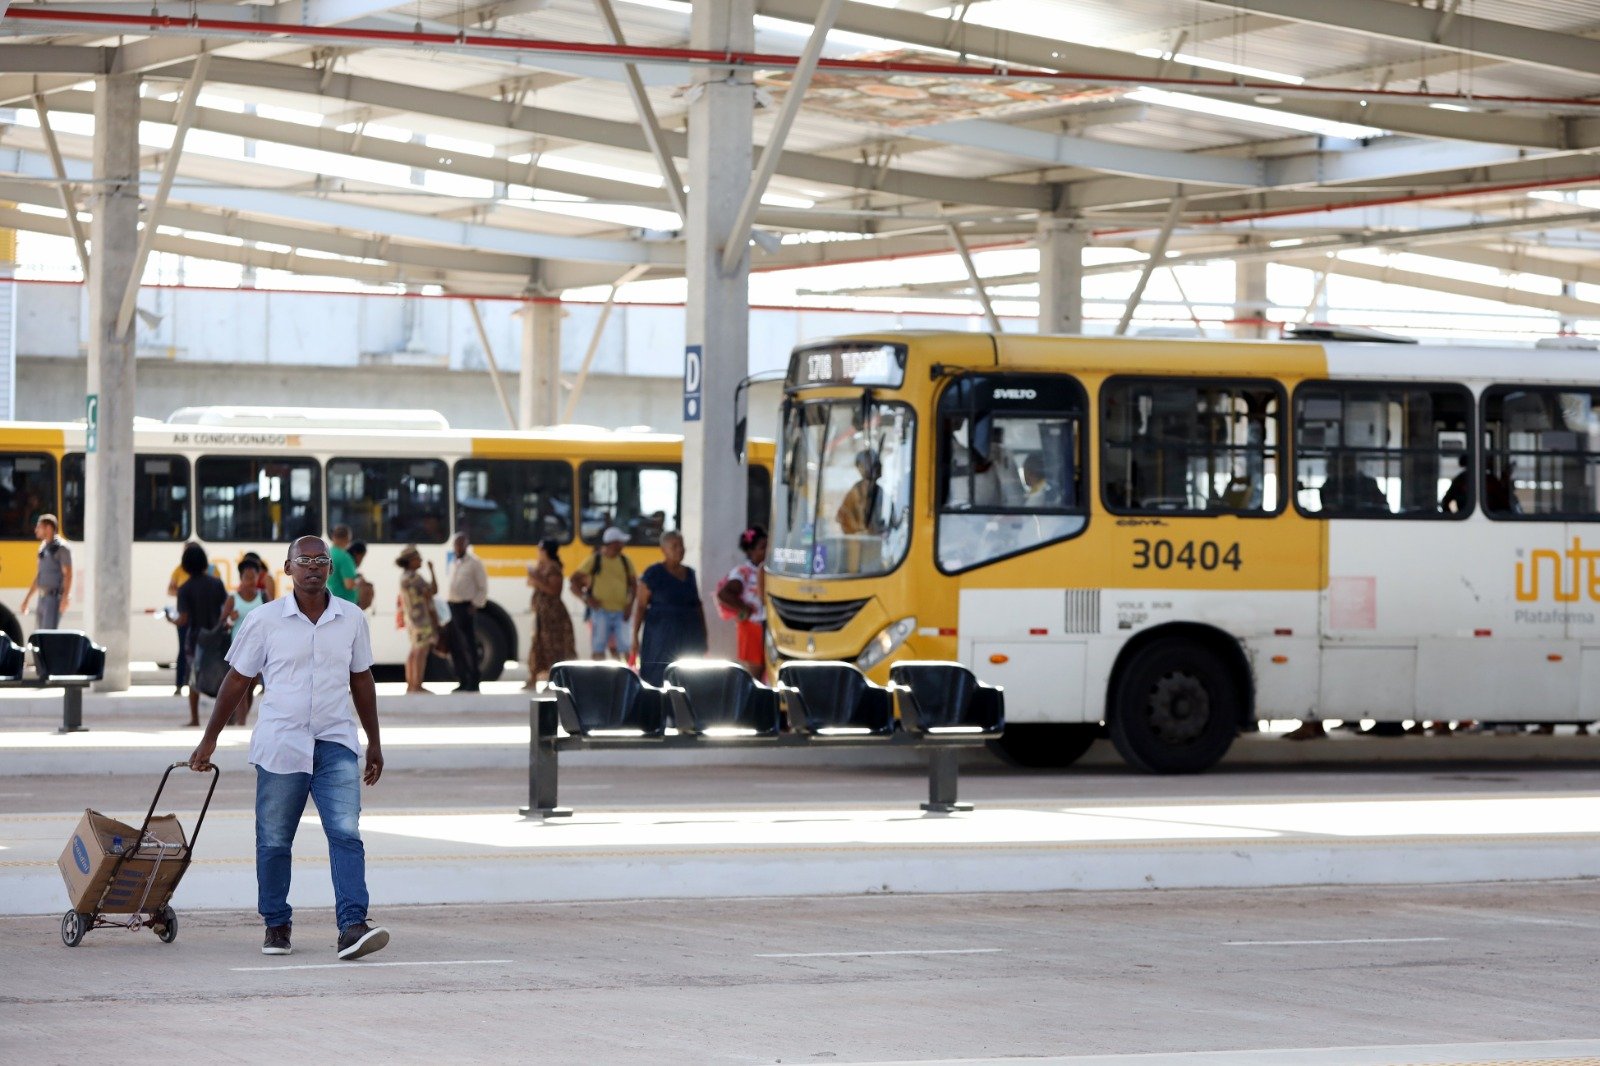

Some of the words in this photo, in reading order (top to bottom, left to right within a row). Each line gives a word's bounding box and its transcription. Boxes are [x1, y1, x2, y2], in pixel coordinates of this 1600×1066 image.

[687, 352, 700, 392] D
[993, 389, 1037, 399] SVELTO
[88, 399, 97, 430] C
[1132, 539, 1242, 571] 30404
[1514, 609, 1595, 623] Plataforma
